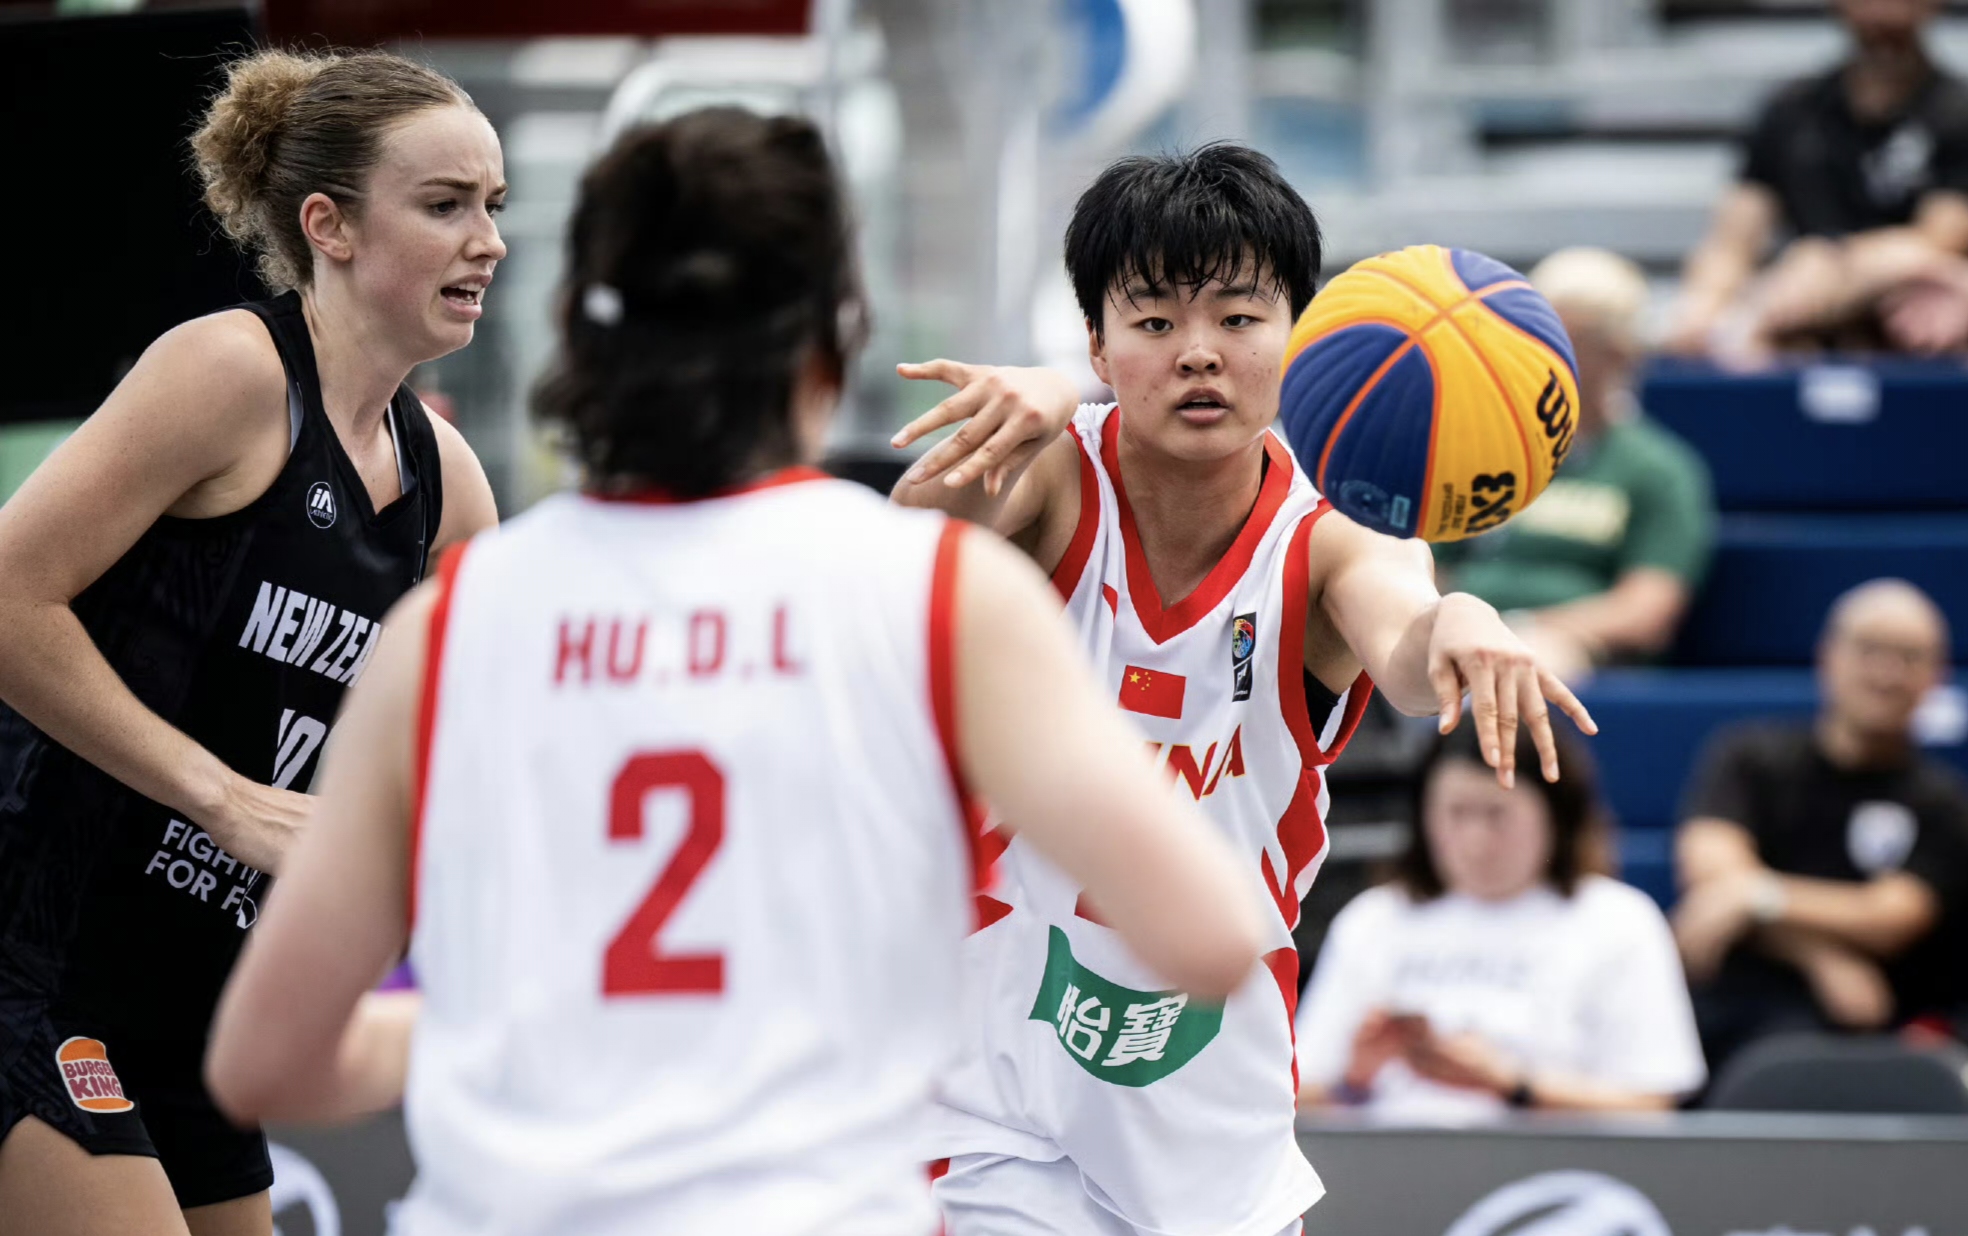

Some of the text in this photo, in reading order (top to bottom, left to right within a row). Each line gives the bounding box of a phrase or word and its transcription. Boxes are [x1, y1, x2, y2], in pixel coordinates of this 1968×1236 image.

[238, 580, 337, 668] NEW
[145, 850, 217, 902] FOR
[602, 750, 726, 999] 2
[1057, 982, 1189, 1067] 怡寶
[68, 1075, 123, 1099] KING
